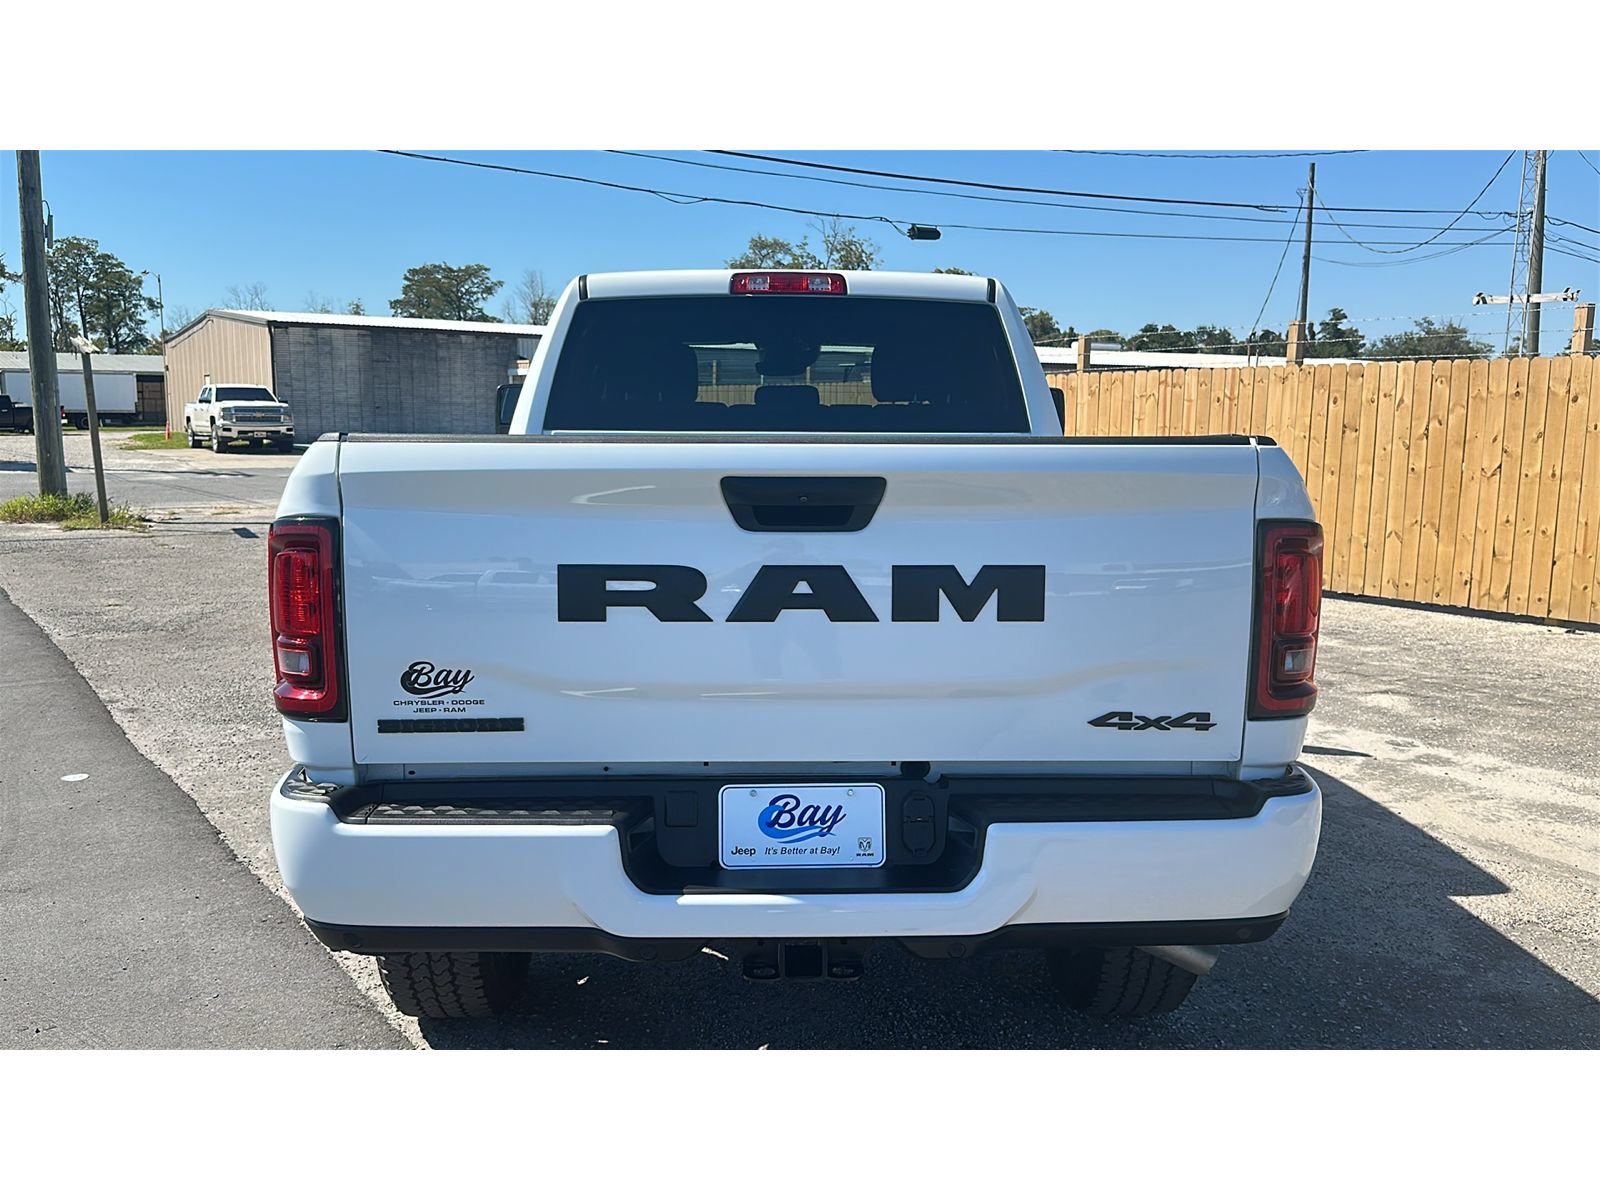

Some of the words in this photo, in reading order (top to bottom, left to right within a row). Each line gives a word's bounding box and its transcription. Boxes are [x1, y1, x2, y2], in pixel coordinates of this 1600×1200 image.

[557, 564, 1046, 623] RAM
[401, 661, 475, 695] Bay
[1087, 711, 1217, 731] 4x4
[762, 794, 847, 838] Bay
[731, 846, 757, 857] Jeep
[764, 847, 778, 855] It's
[780, 846, 808, 855] Better
[809, 847, 819, 855] at
[820, 846, 841, 857] Bay!
